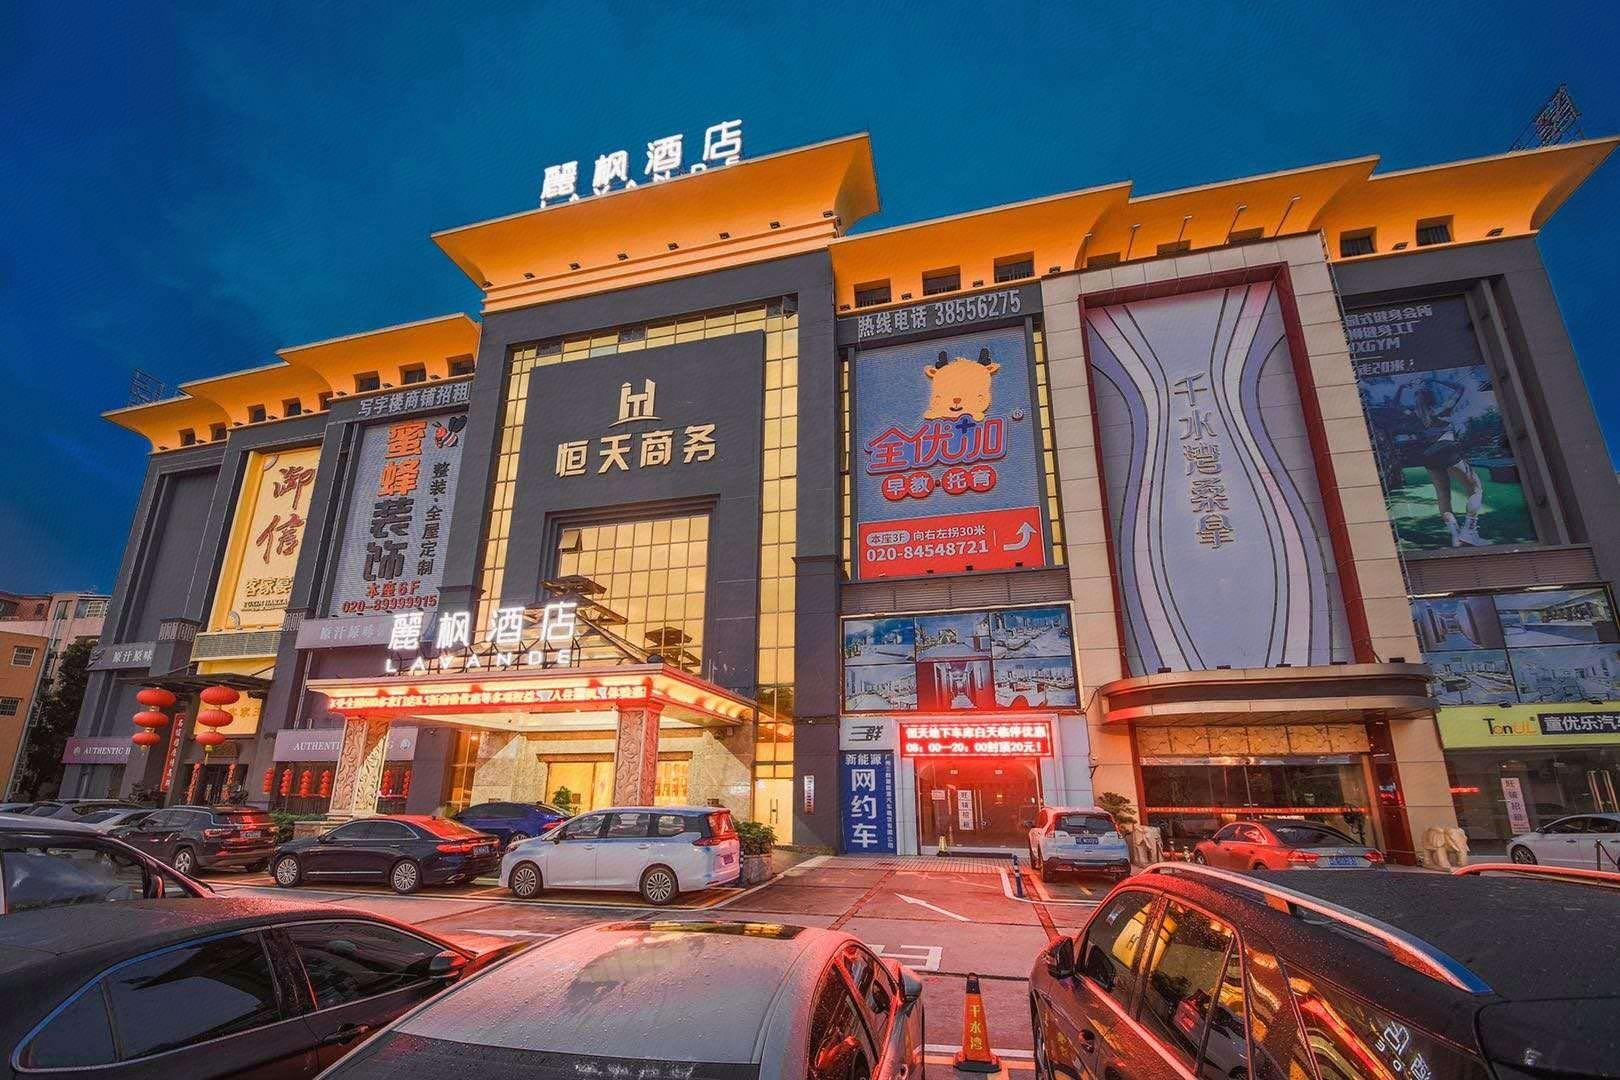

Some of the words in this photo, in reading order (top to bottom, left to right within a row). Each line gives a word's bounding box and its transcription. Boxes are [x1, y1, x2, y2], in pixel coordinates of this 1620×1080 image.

[858, 306, 928, 338] 热线电话
[934, 289, 1022, 326] 38556275
[359, 381, 470, 416] 写字楼商铺招租
[555, 423, 717, 478] 恒天商务
[256, 466, 316, 564] 御信
[866, 539, 989, 563] 020-84548721
[869, 532, 908, 545] 本座3F
[385, 649, 571, 673] LAVANDE
[294, 741, 342, 751] AUTHENTI
[845, 753, 883, 767] 新能源
[850, 768, 878, 848] 网约车
